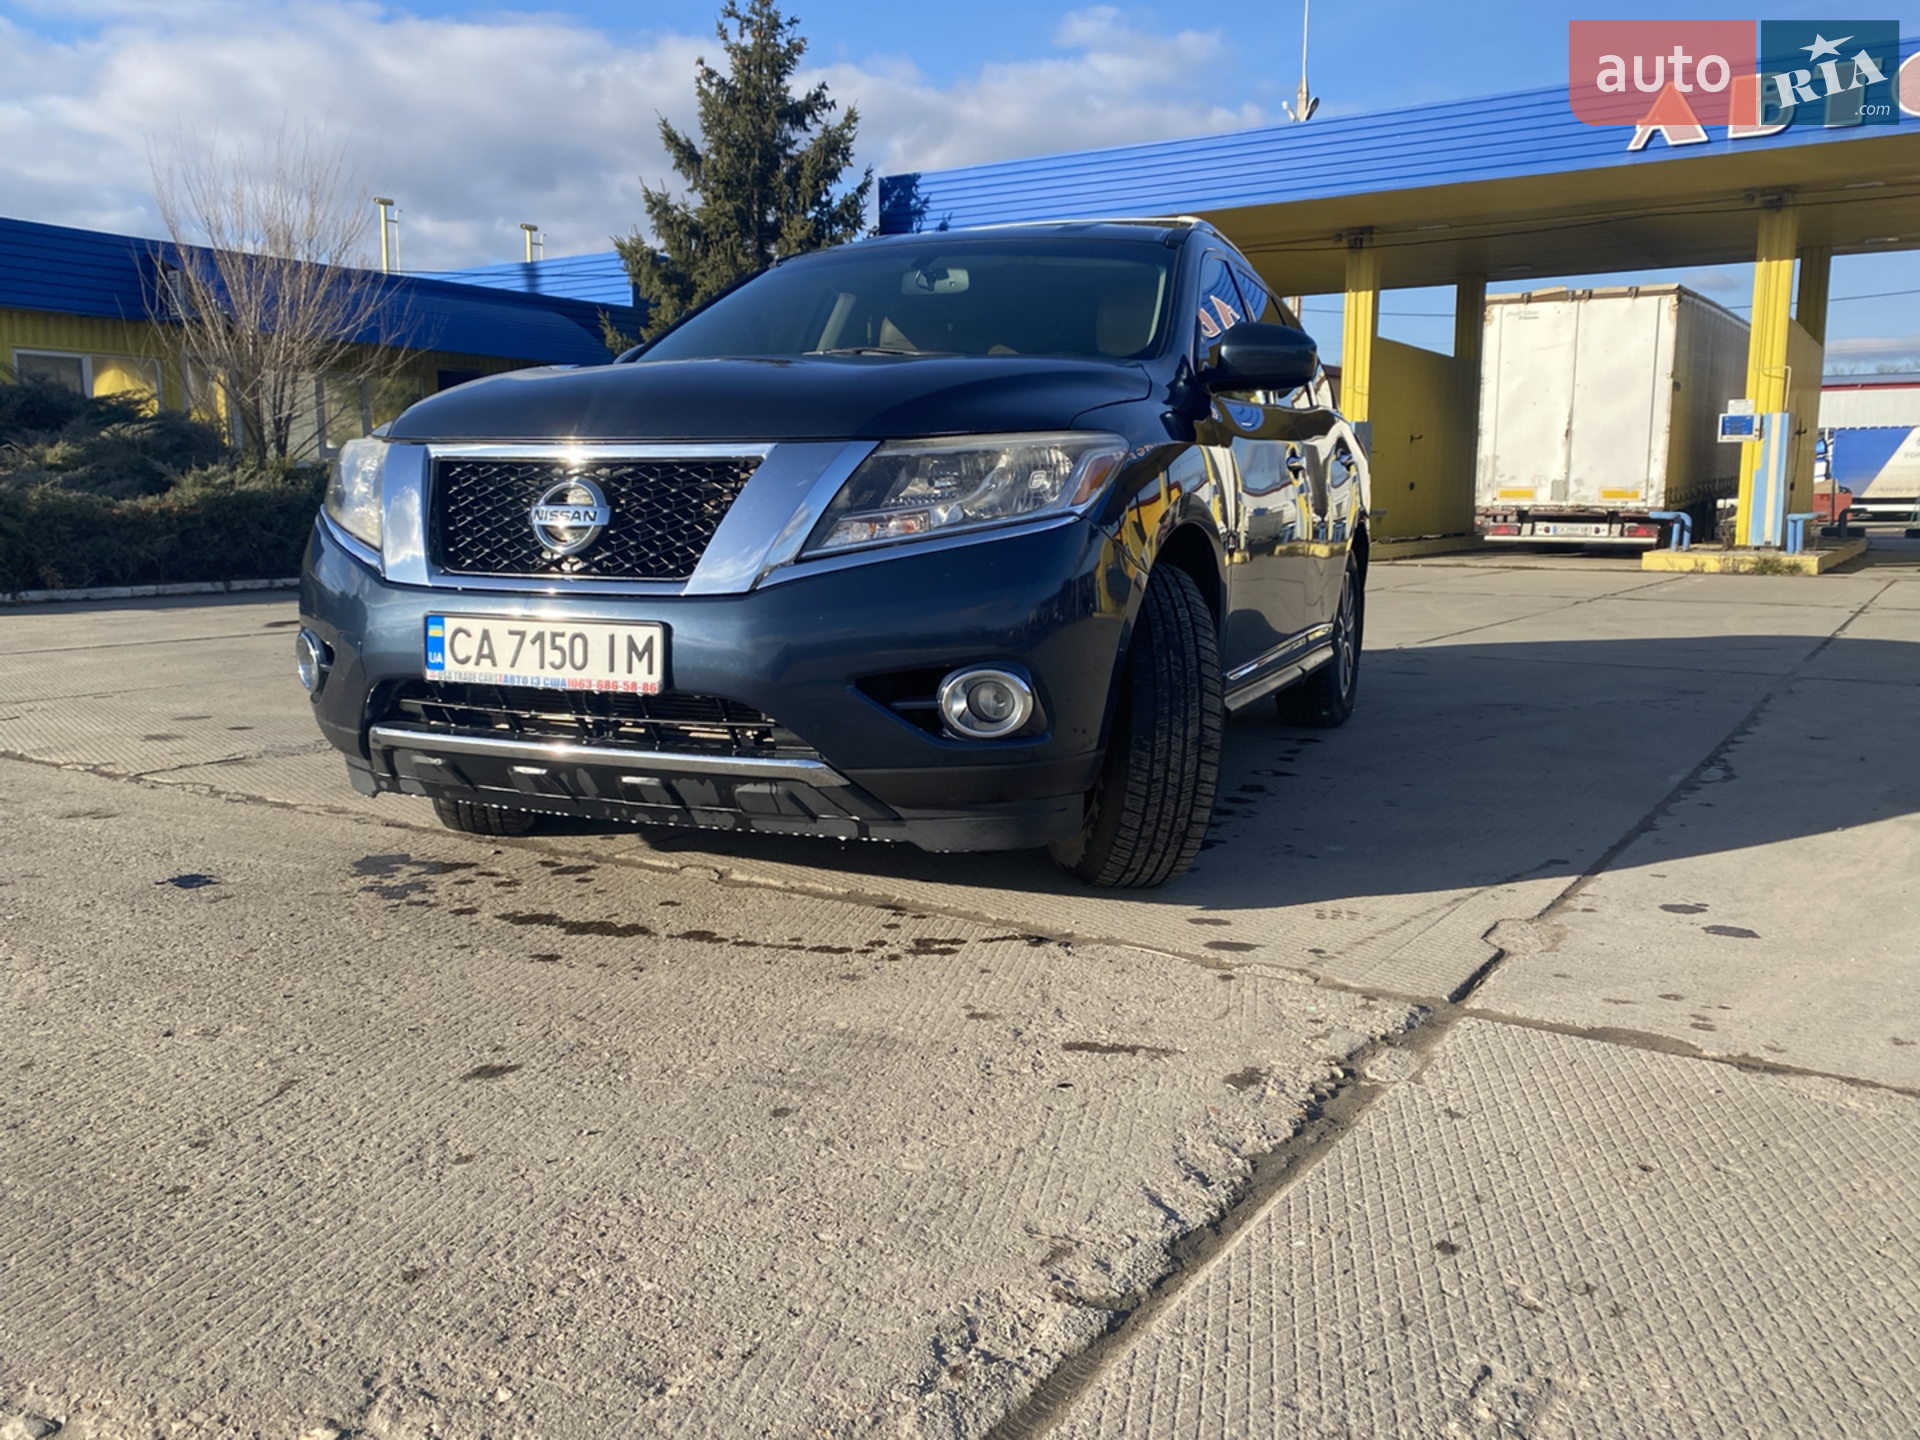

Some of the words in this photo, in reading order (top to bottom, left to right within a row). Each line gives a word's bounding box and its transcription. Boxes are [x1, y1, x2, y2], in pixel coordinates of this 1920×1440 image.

[533, 509, 598, 522] NISSAN
[428, 651, 444, 664] UA
[448, 626, 498, 668] CA
[507, 629, 589, 671] 7150
[608, 632, 655, 676] IM
[438, 671, 453, 681] USA
[453, 672, 477, 682] TRADE
[477, 673, 498, 683] CARS
[502, 675, 529, 685] АВТО
